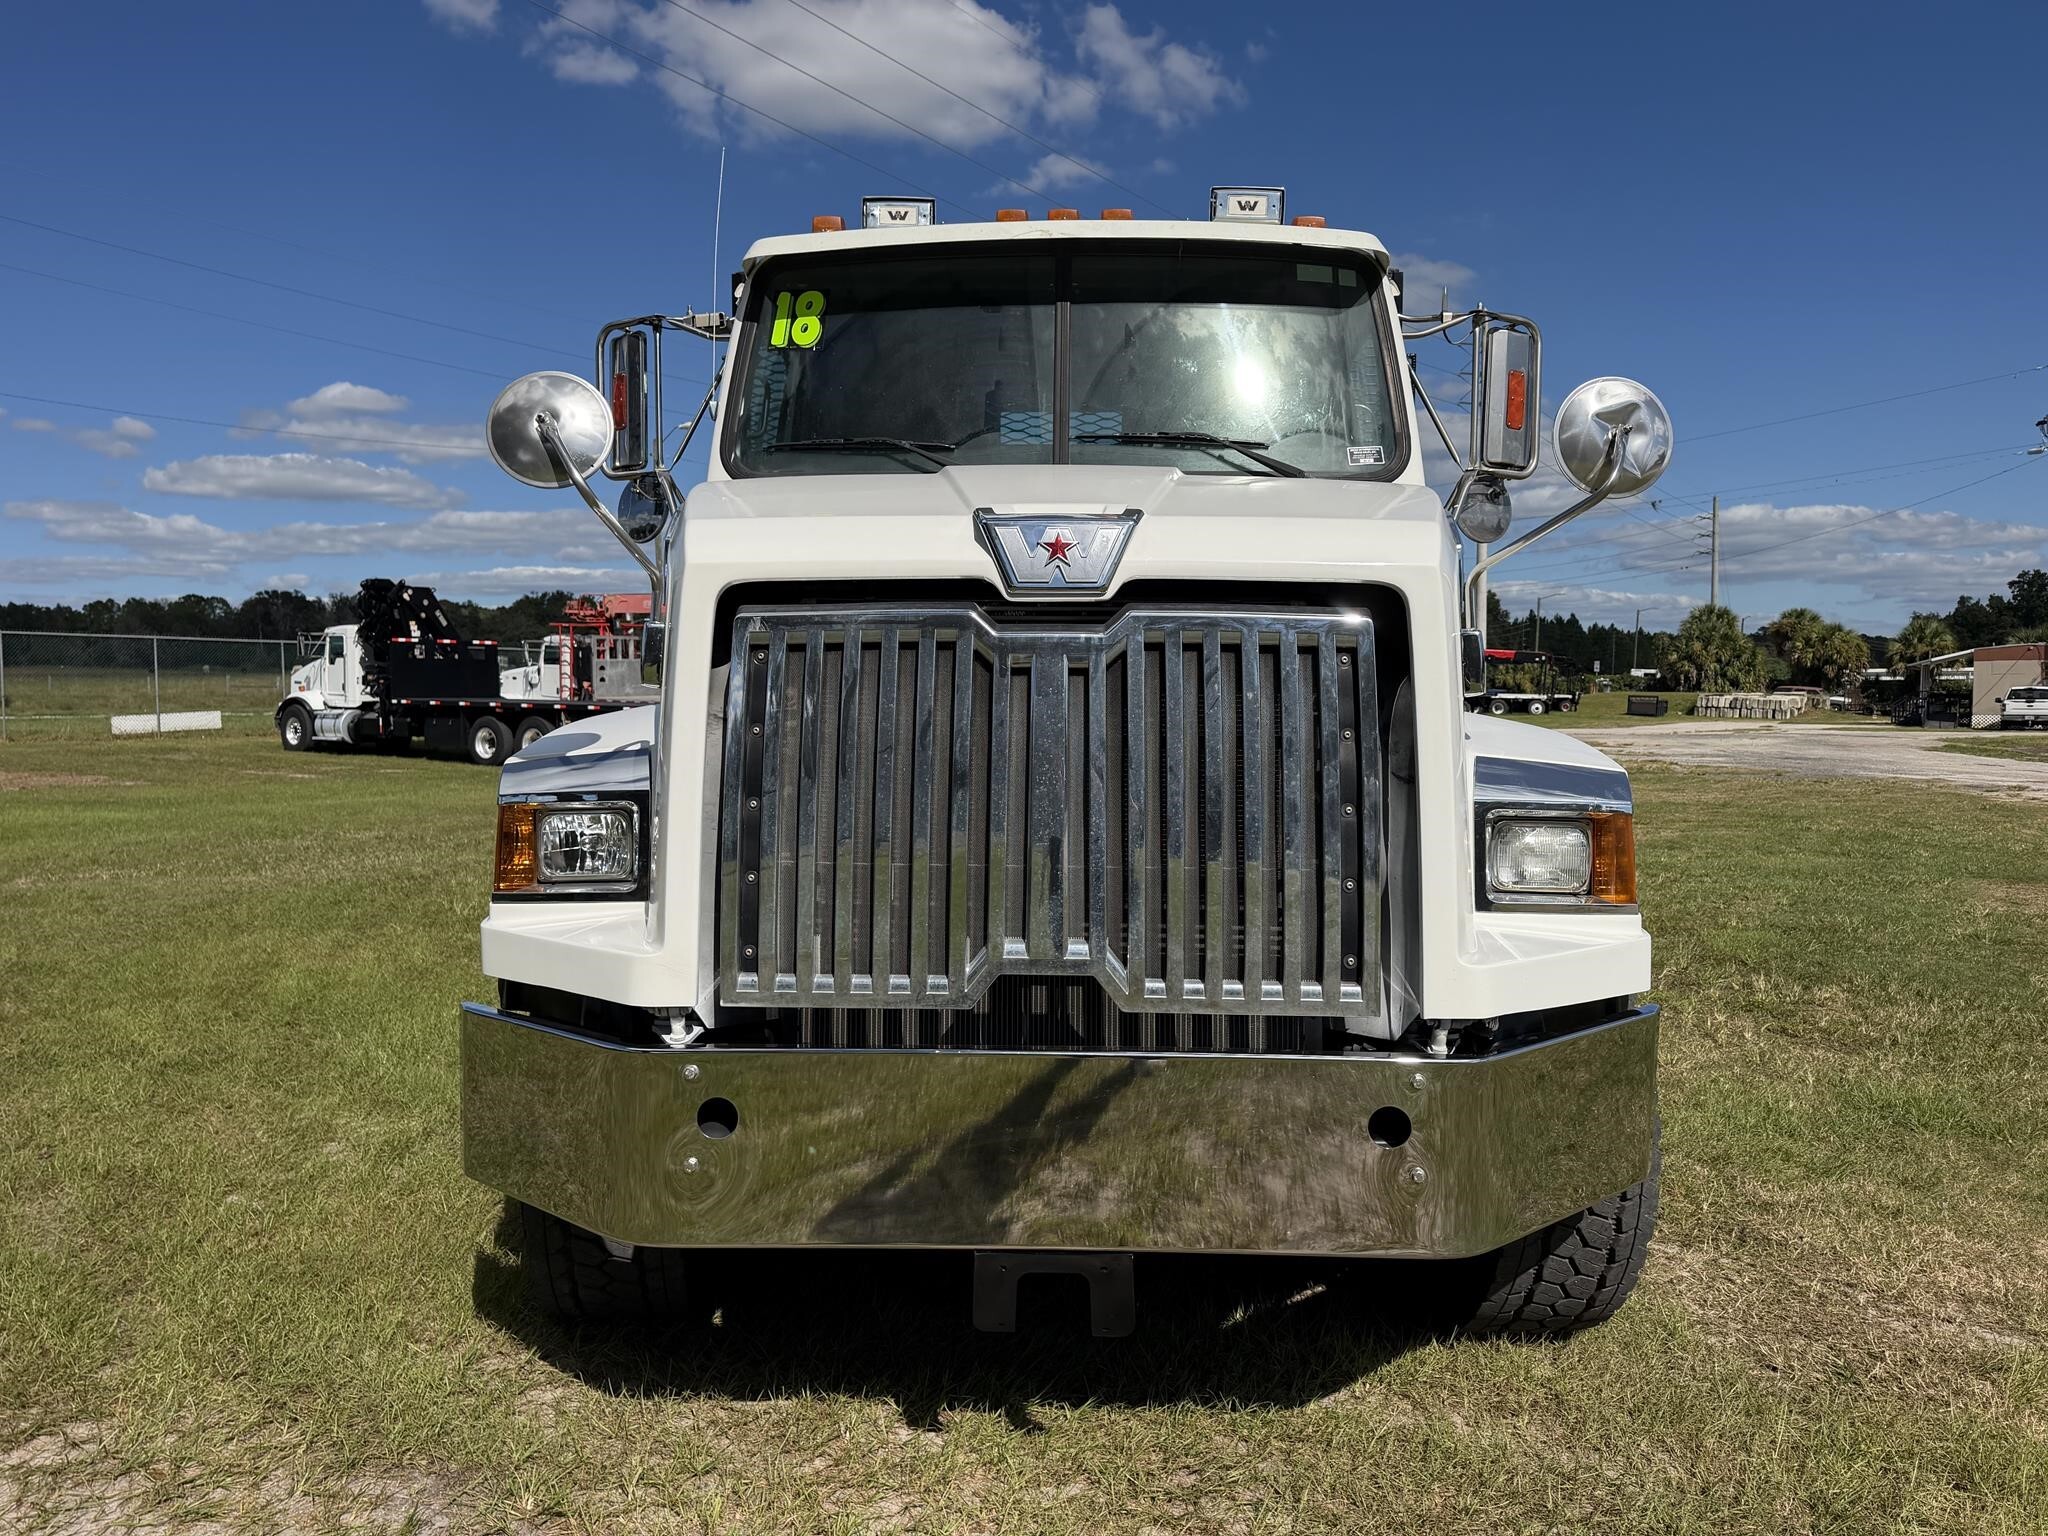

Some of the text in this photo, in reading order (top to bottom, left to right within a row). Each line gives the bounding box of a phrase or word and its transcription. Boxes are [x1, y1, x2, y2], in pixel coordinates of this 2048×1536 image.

[887, 210, 910, 221] W
[1236, 200, 1259, 211] W
[770, 290, 826, 348] 18
[994, 526, 1124, 584] W
